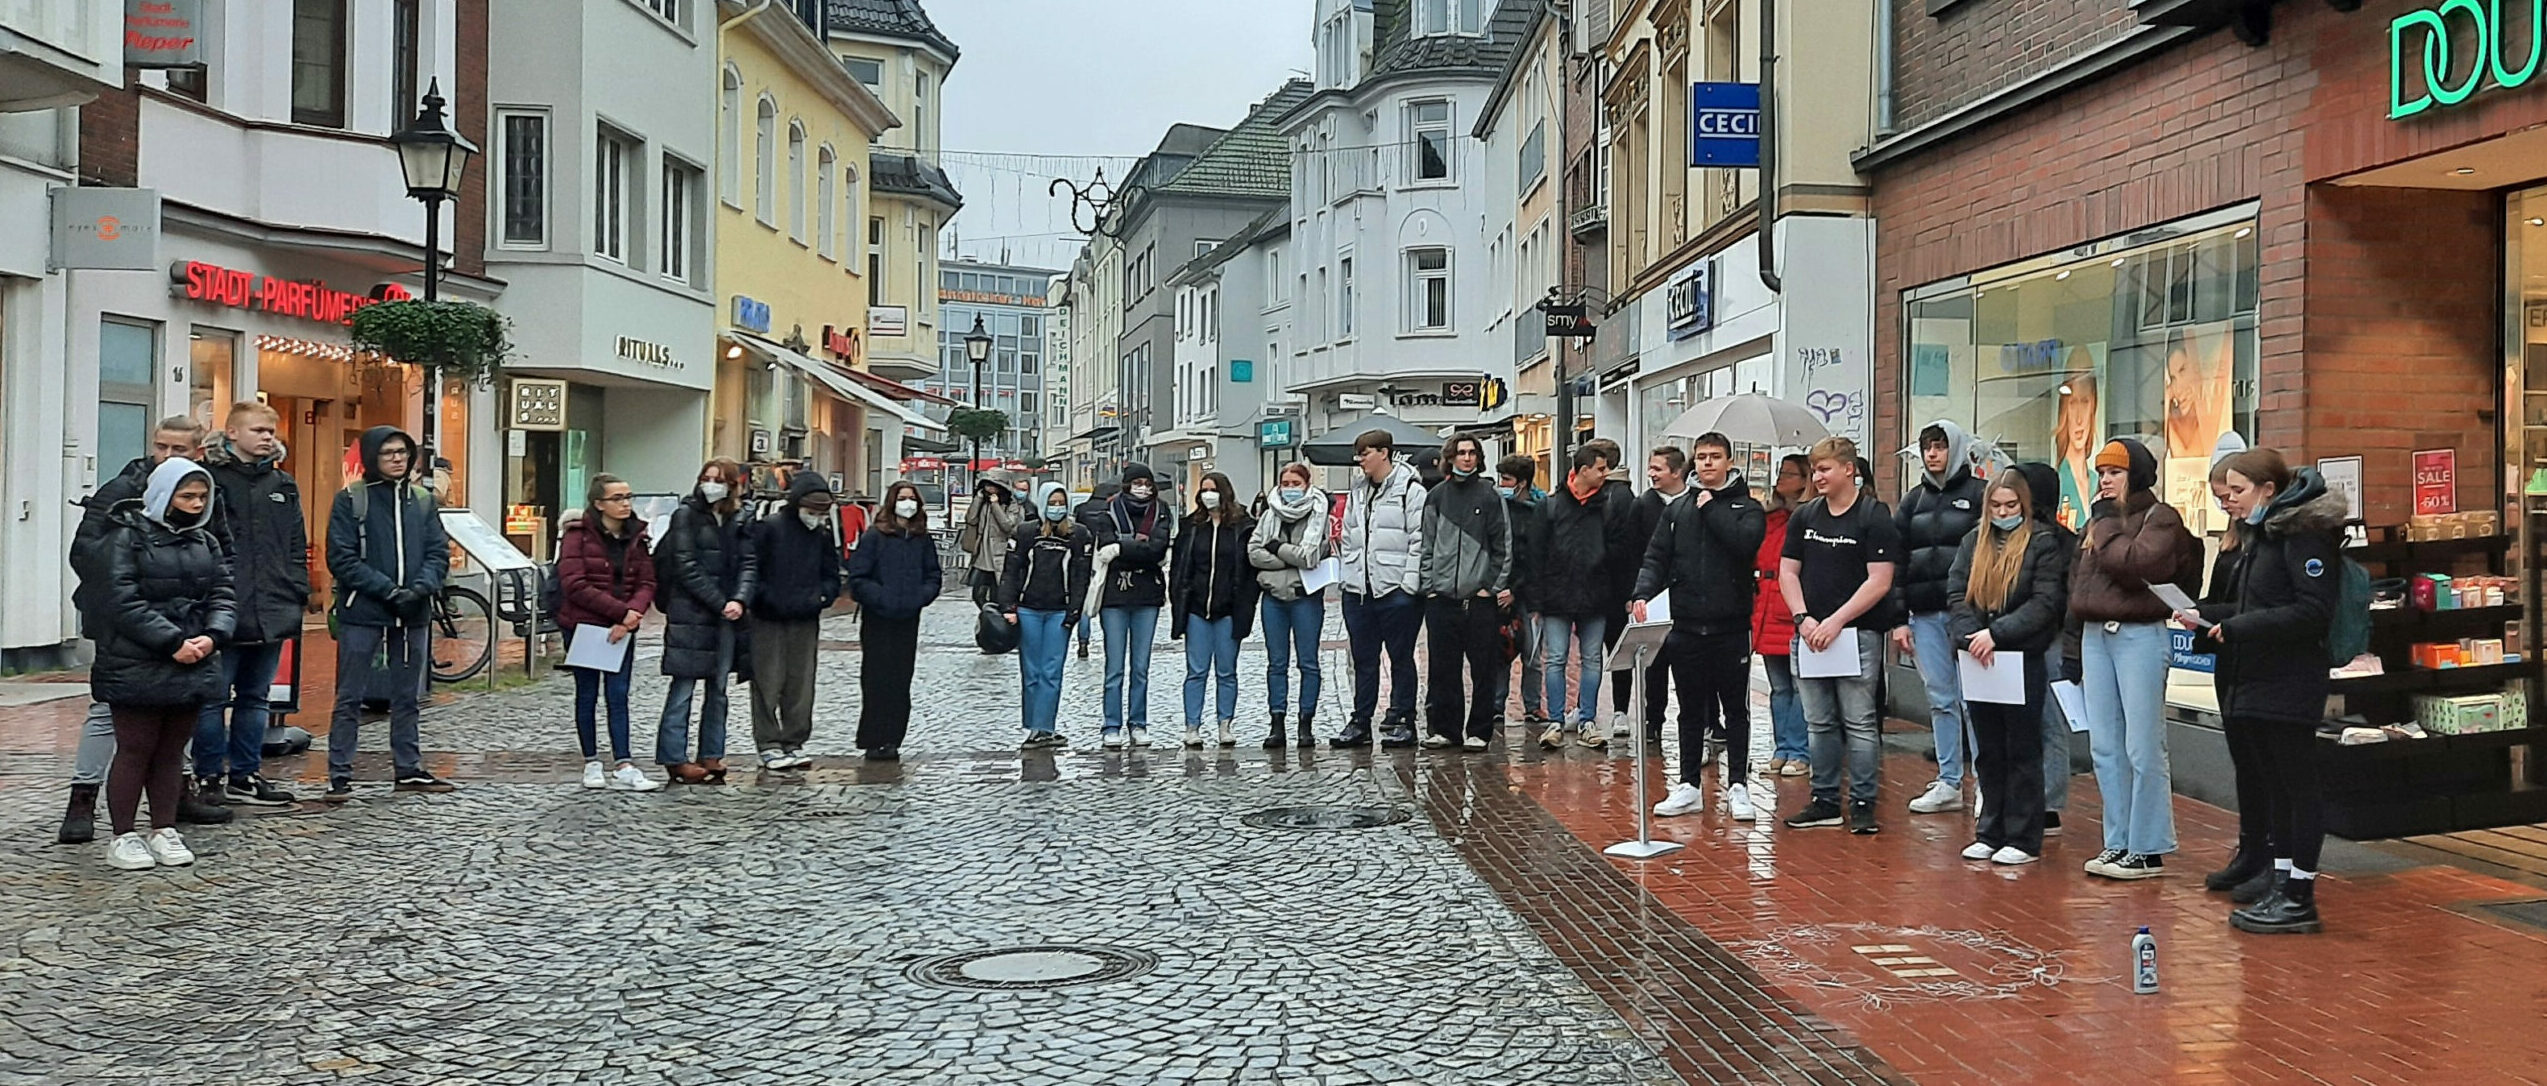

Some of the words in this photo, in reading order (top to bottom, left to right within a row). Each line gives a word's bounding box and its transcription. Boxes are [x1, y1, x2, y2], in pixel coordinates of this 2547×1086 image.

[2391, 0, 2547, 119] DOU
[1699, 113, 1761, 134] CECI
[1058, 307, 1069, 406] DEICHMANN
[173, 366, 184, 383] 16
[521, 387, 558, 398] RIT
[1378, 384, 1443, 408] Tam
[2417, 470, 2451, 485] SALE
[1803, 528, 1857, 548] Champion
[2173, 634, 2196, 651] DOU
